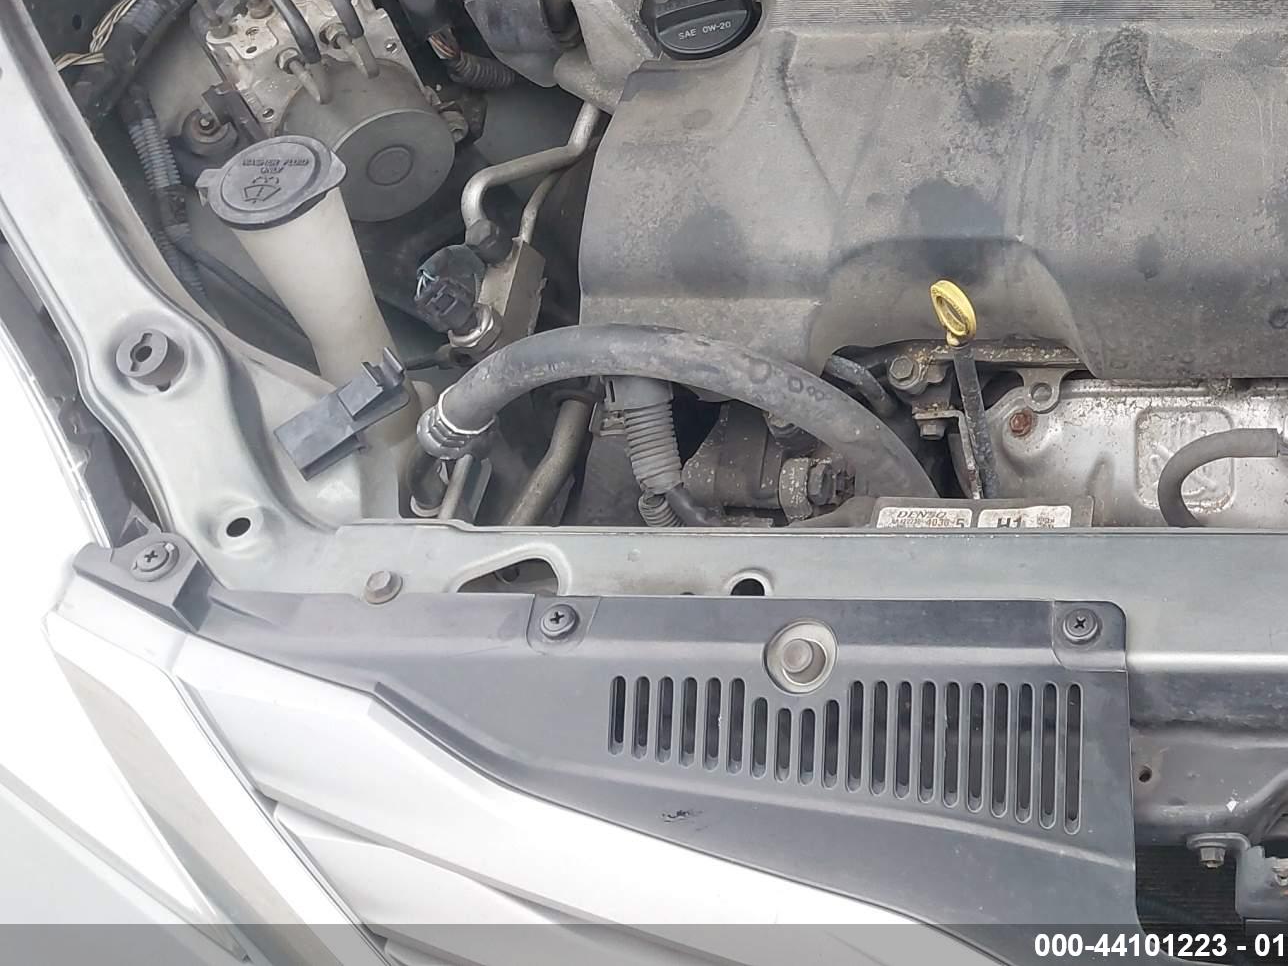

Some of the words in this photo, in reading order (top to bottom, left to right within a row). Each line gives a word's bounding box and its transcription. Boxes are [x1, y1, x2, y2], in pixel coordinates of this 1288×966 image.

[678, 28, 697, 41] SAE
[702, 21, 732, 34] 0W-20
[896, 510, 946, 519] DENSO
